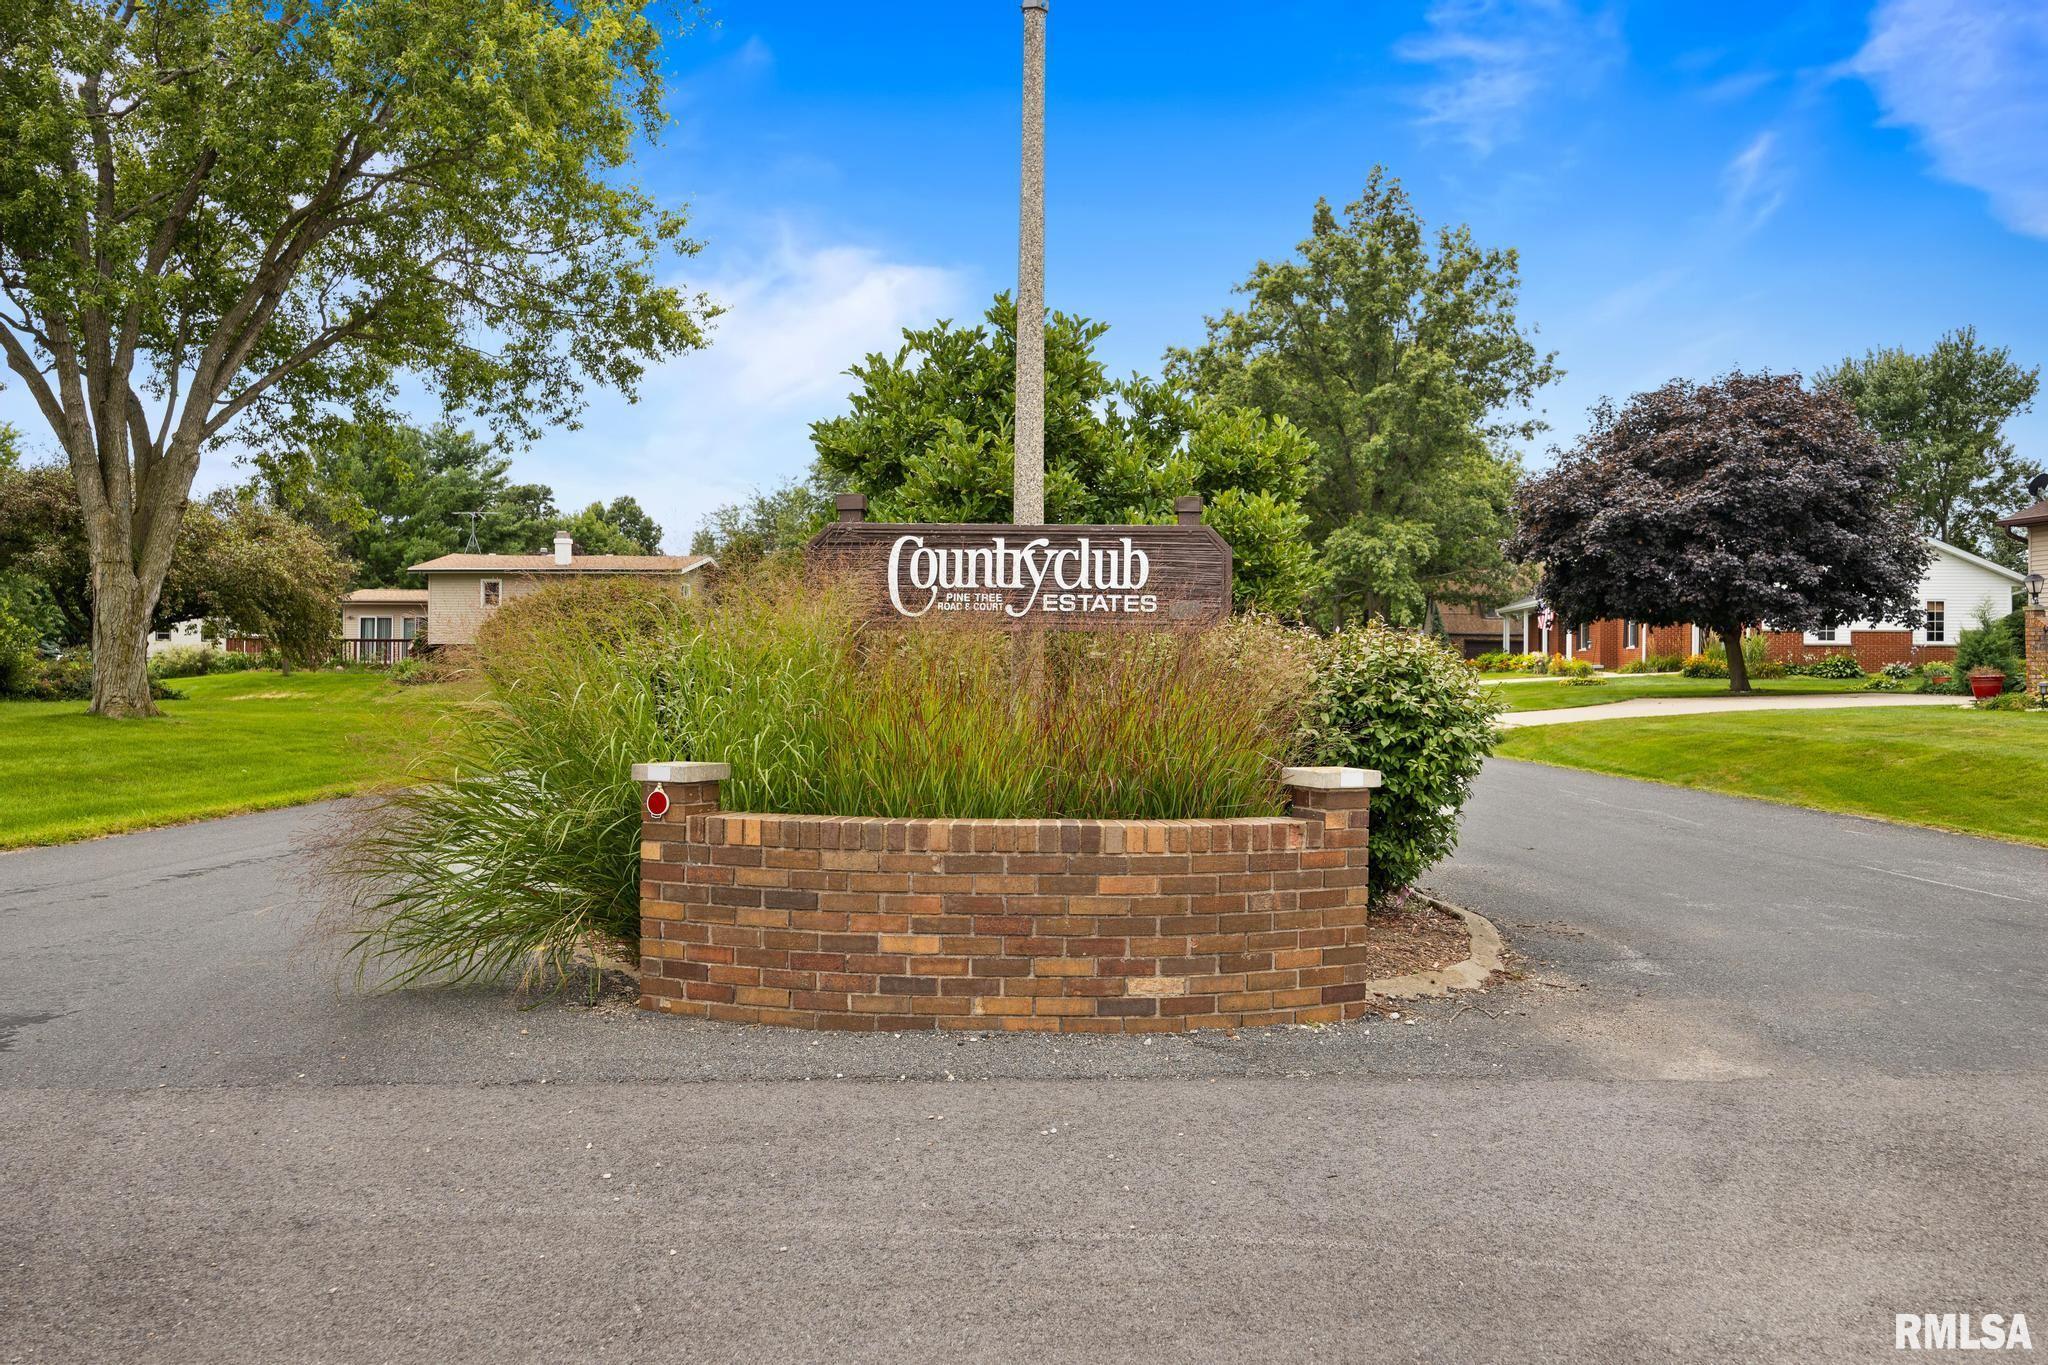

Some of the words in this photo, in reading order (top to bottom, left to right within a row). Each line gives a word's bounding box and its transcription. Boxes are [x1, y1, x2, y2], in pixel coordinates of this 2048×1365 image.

[946, 592, 970, 602] PINE
[975, 592, 1003, 602] TREE
[937, 602, 963, 611] ROAD
[973, 602, 1004, 611] COURT
[1042, 594, 1158, 613] ESTATES
